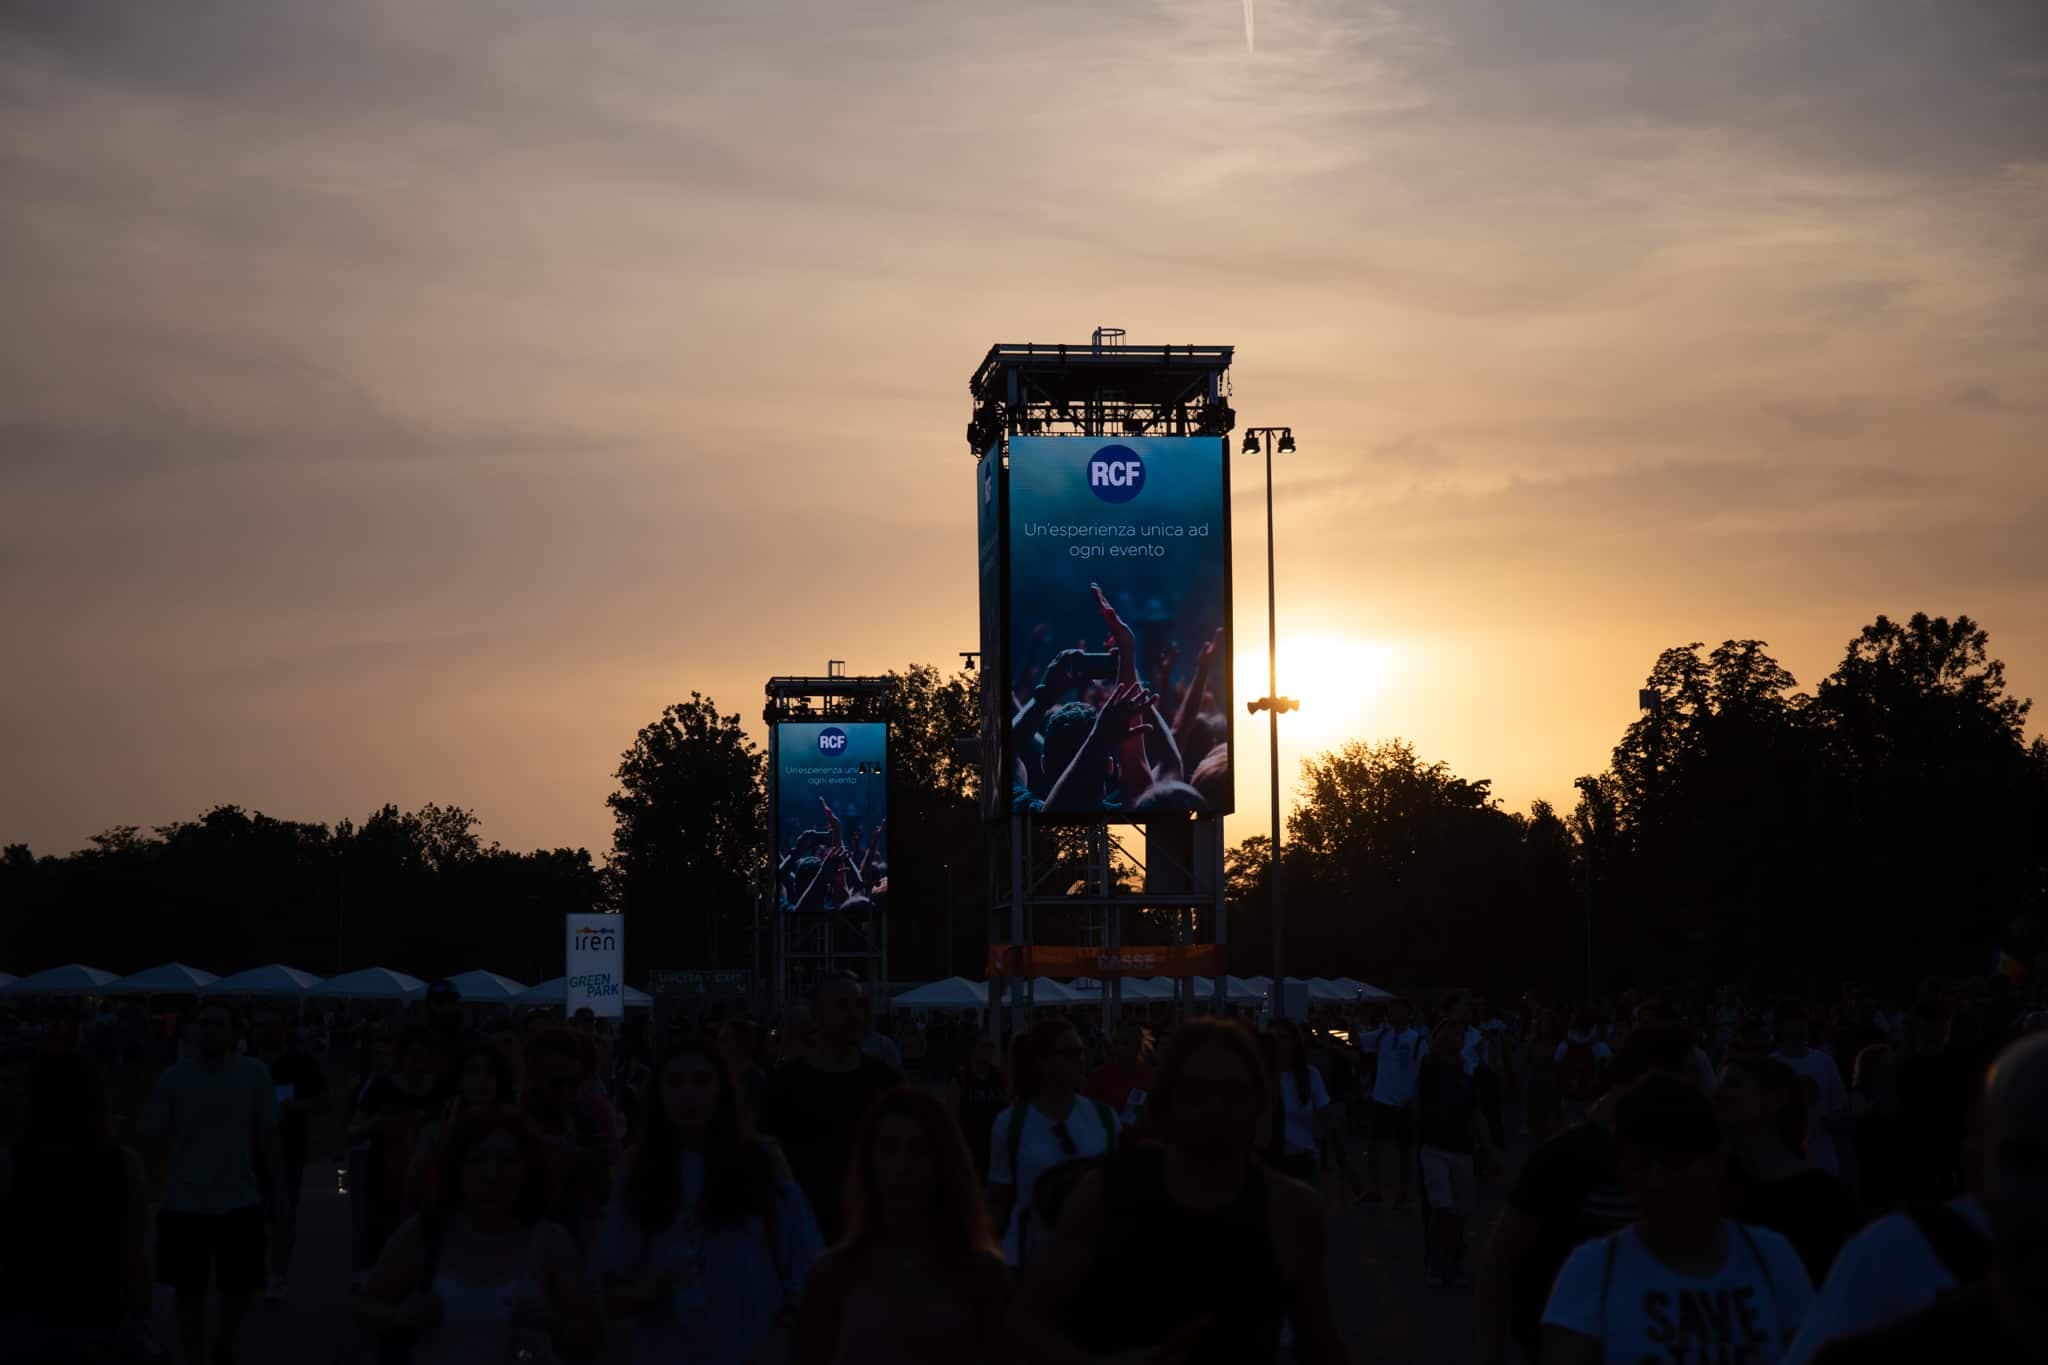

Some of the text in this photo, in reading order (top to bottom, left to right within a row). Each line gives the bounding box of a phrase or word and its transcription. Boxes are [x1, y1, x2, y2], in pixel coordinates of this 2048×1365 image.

[1091, 461, 1141, 487] RCF
[1024, 522, 1209, 539] Un'esperienza unica ad
[1069, 542, 1165, 559] ogni evento
[819, 735, 845, 749] RCF
[575, 935, 615, 951] iren
[569, 973, 611, 988] GREEN
[587, 984, 619, 998] PARK
[1643, 1286, 1769, 1344] SAVE
